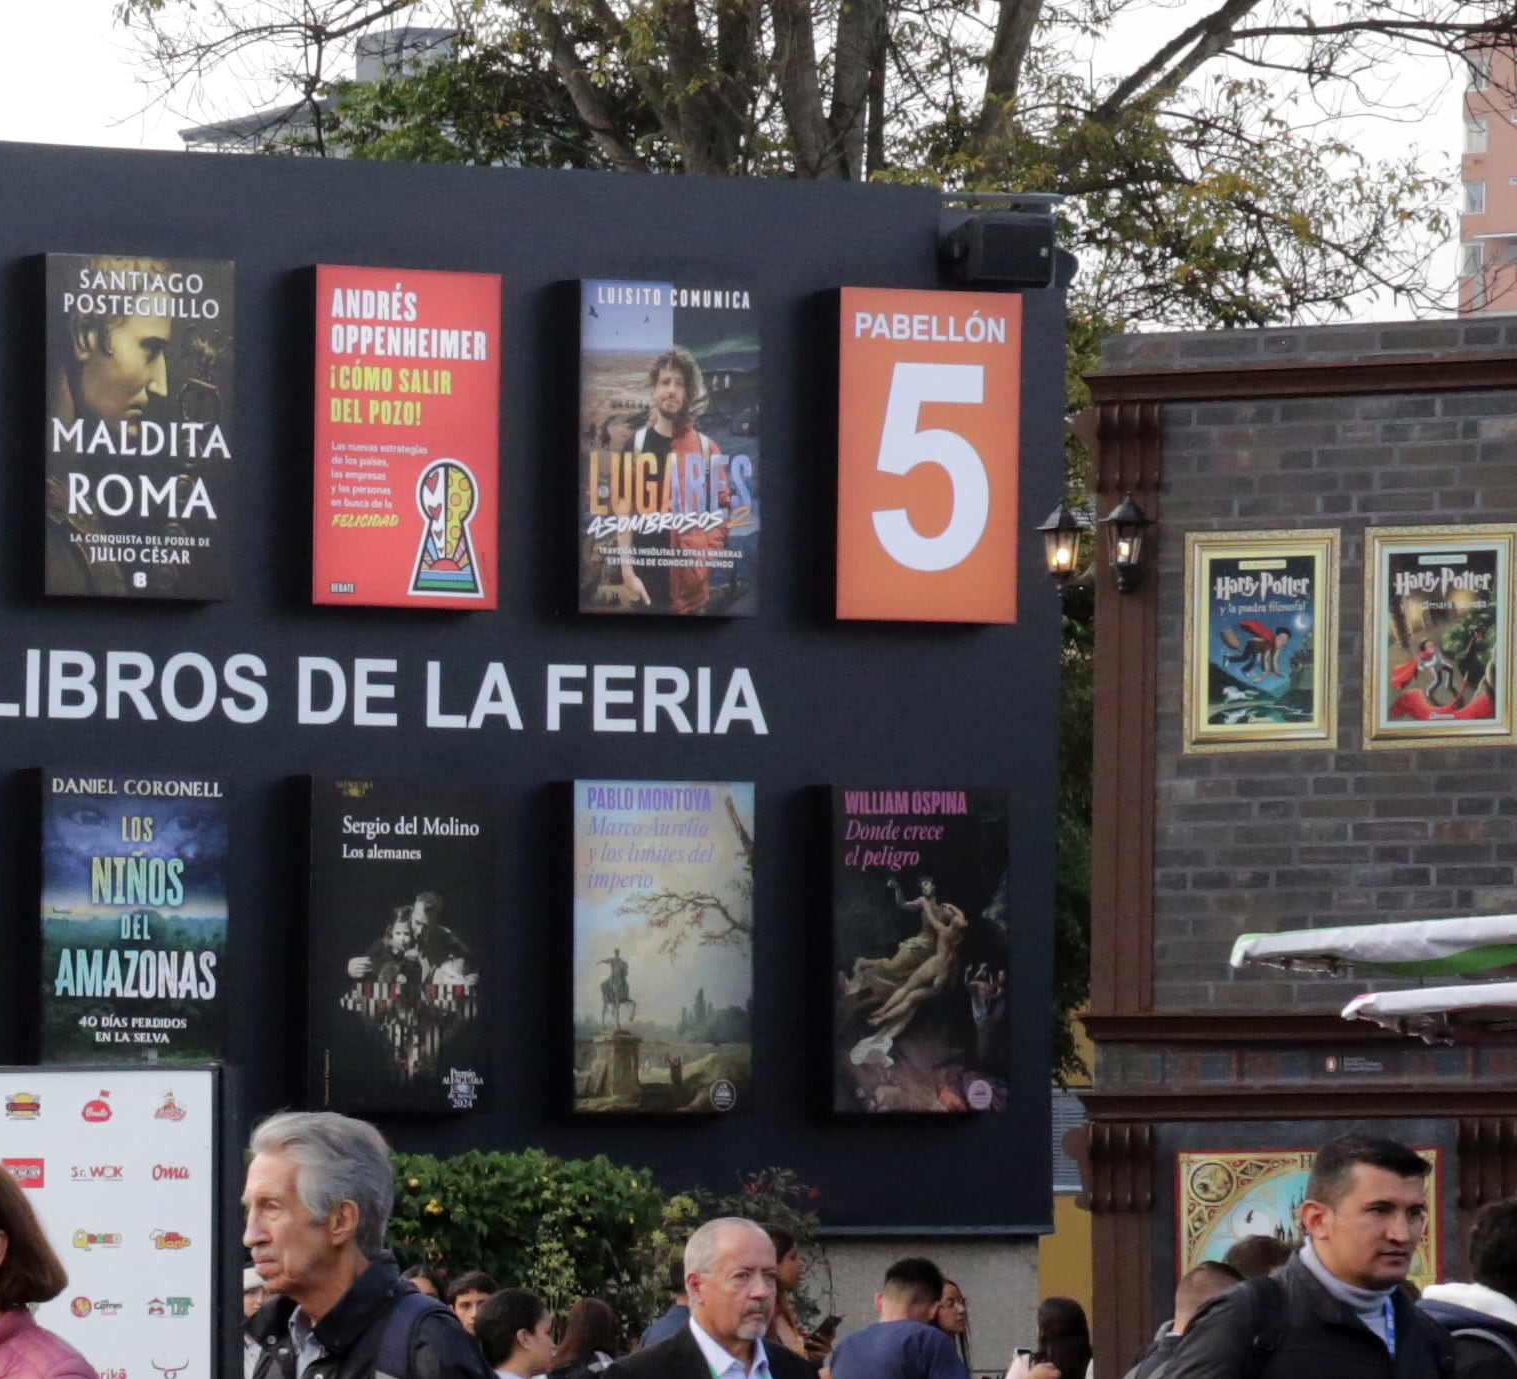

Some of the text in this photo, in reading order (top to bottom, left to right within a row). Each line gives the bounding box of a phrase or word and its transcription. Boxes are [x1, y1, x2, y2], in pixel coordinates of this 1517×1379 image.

[79, 269, 204, 295] SANTIAGO
[63, 292, 220, 320] POSTEGUILLO
[331, 282, 418, 322] ANDRÉS
[597, 286, 751, 310] LUISITO COMUNICA
[854, 309, 1006, 343] PABELLÓN
[331, 323, 487, 361] OPPENHEIMER
[329, 358, 452, 395] ¡CÓMO SALIR
[330, 397, 422, 427] DEL POZO!
[51, 417, 233, 459] MALDITA
[871, 360, 990, 572] 5
[67, 472, 217, 520] ROMA
[589, 450, 753, 517] LUGARES
[332, 513, 400, 529] FELICIDAD
[586, 510, 725, 539] ASOMBROSOS
[89, 546, 191, 565] JULIO CÉSAR
[1213, 571, 1311, 602] Harry Potter
[1393, 566, 1492, 598] Harry Potter
[297, 655, 398, 727] DE
[425, 660, 525, 731] LA
[546, 662, 770, 736] FERIA
[51, 776, 224, 798] DANIEL CORONELL
[586, 786, 712, 813] PABLO MONTOYA
[844, 790, 968, 817] WILLIAM OSPINA
[121, 815, 154, 843] LOS
[341, 814, 481, 841] Sergio del Molino
[903, 823, 945, 842] crece
[341, 843, 423, 861] Los alemanes
[844, 845, 921, 872] el peligro
[91, 850, 185, 907] NIÑOS
[121, 914, 152, 941] DEL
[55, 948, 217, 1000] AMAZONAS
[78, 1012, 188, 1030] 40 DÍAS PERDIDOS
[95, 1031, 170, 1044] EN LA SELVA
[152, 1163, 191, 1182] Oma
